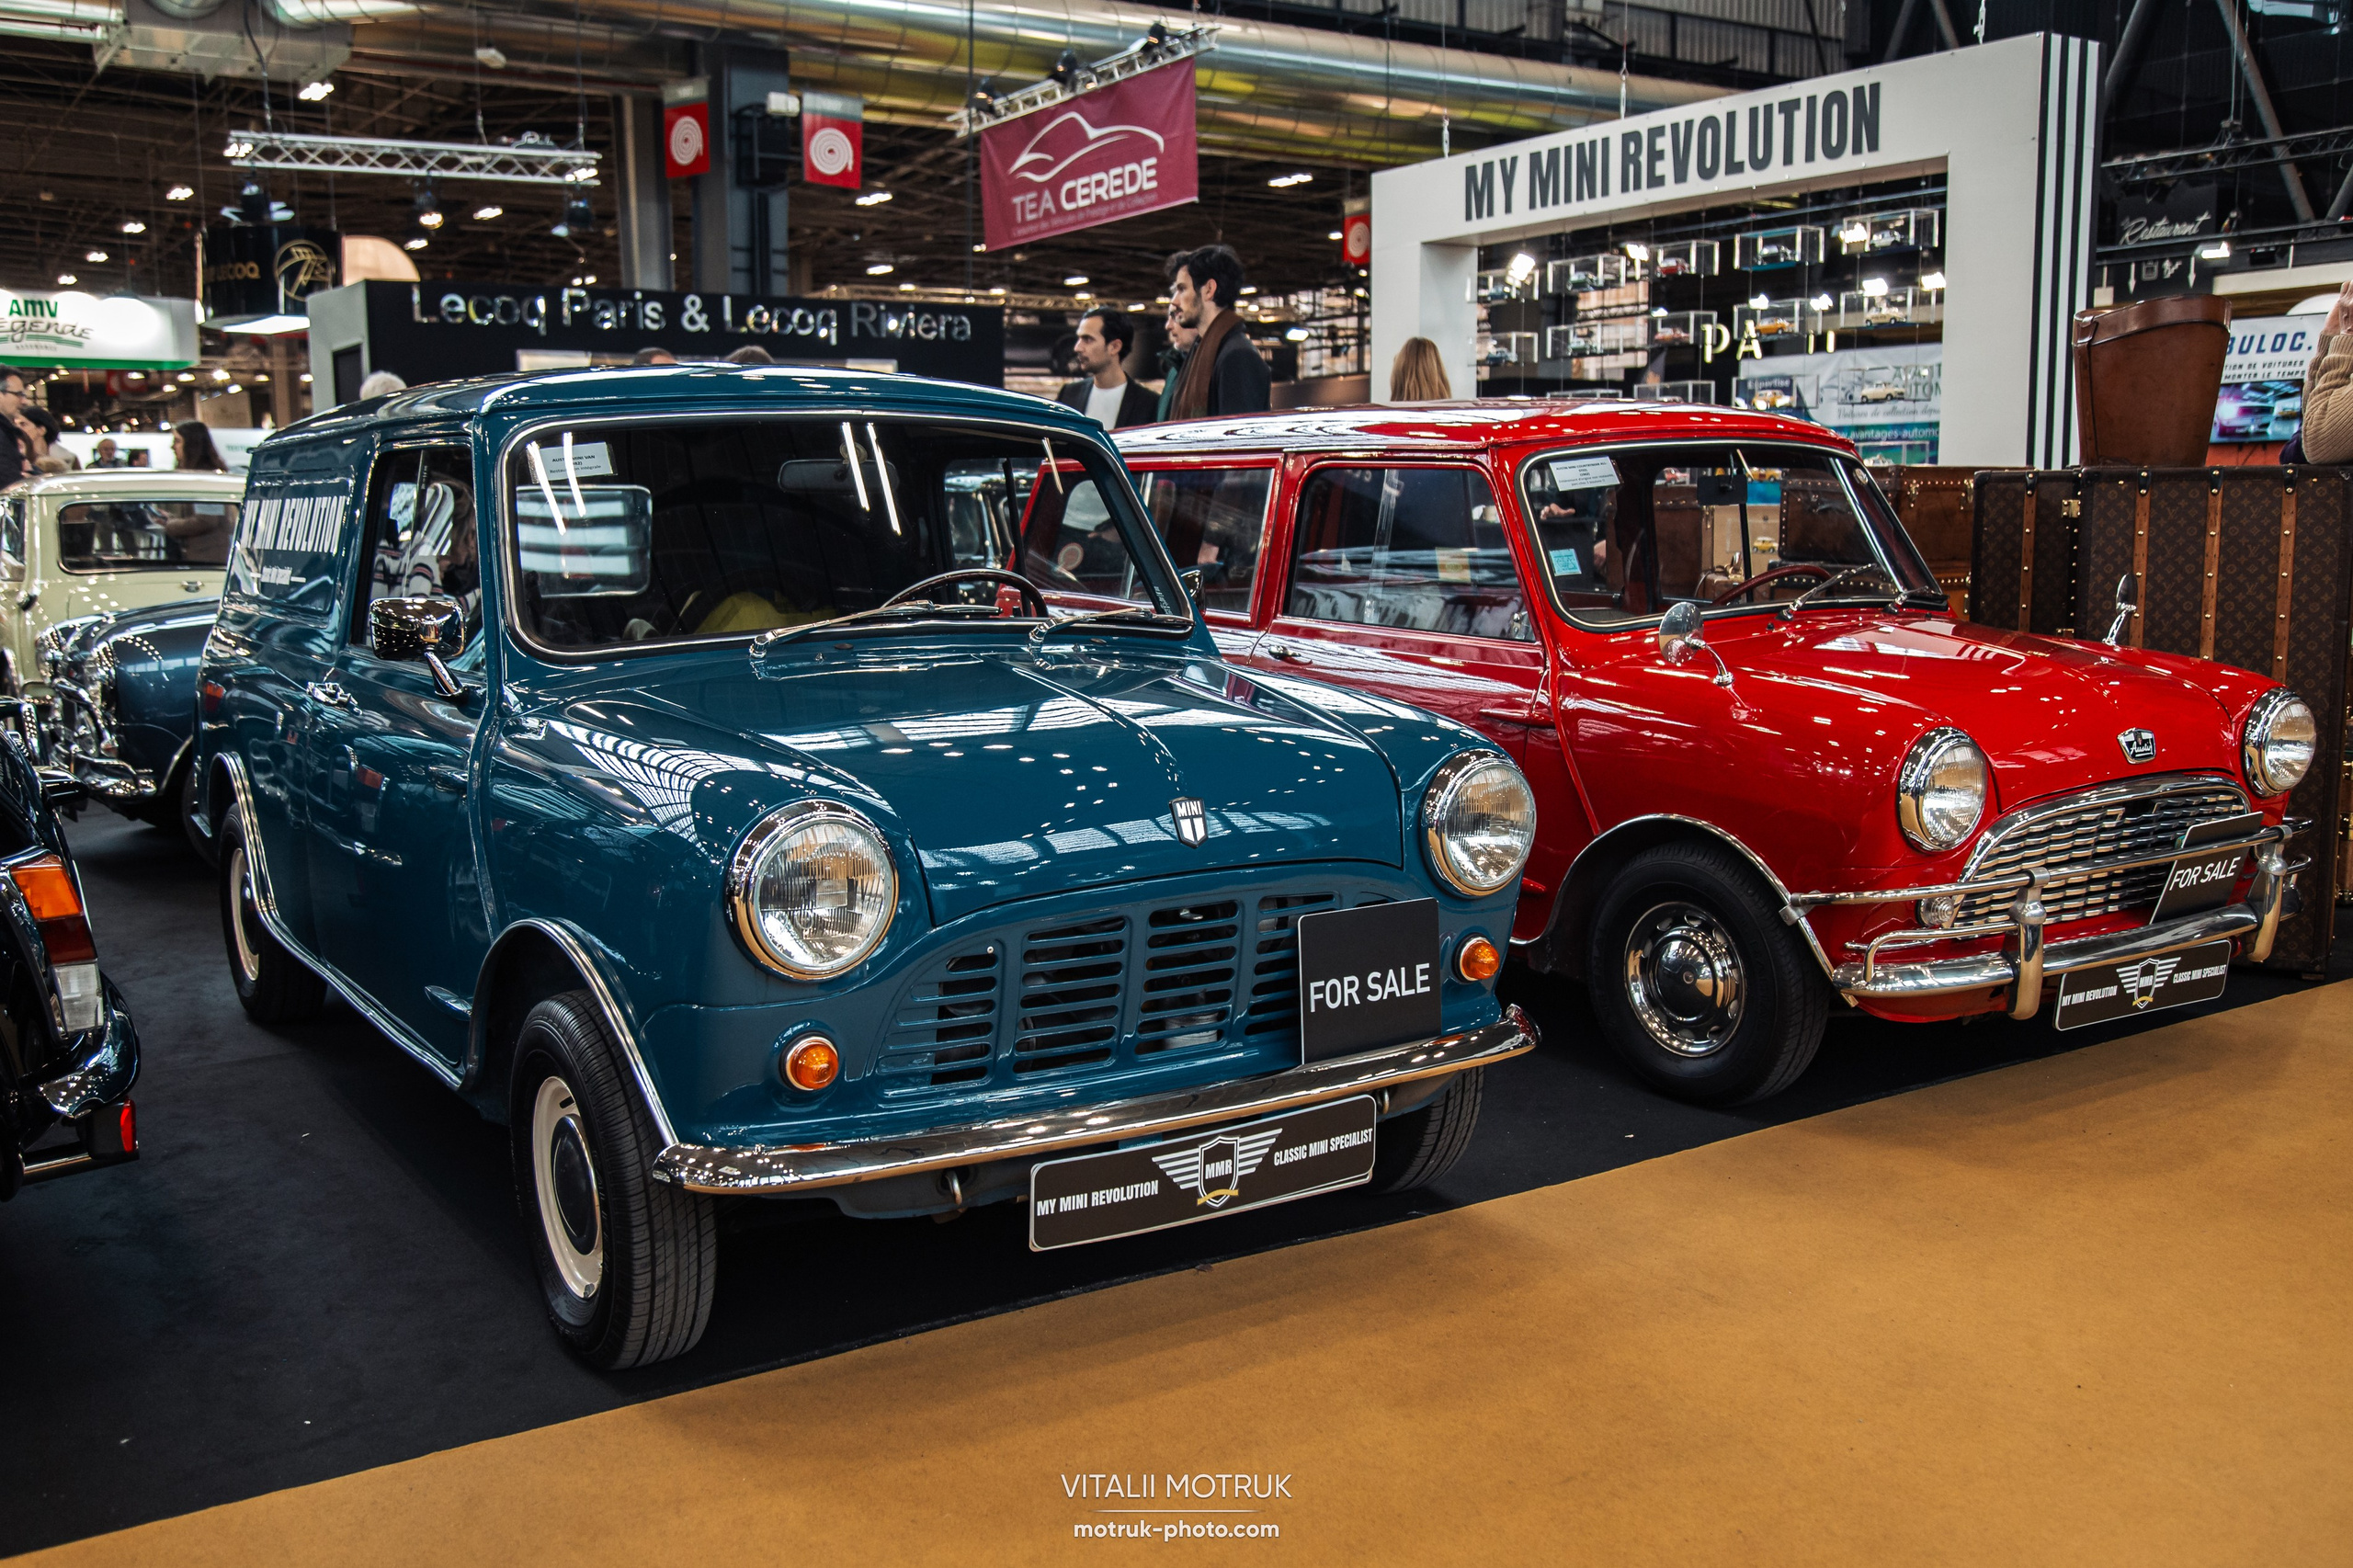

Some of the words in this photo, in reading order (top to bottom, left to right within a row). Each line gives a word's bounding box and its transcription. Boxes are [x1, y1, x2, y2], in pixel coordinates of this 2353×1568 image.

[1464, 155, 1518, 222] MY
[1529, 137, 1610, 210] MINI
[1620, 82, 1881, 194] REVOLUTION
[1012, 187, 1056, 223] TEA
[1060, 157, 1158, 211] CEREDE
[2119, 210, 2211, 246] Restaurant
[9, 299, 58, 318] AMV
[413, 282, 547, 336] Lecoq
[562, 288, 666, 331] Paris
[681, 293, 710, 333] &
[722, 294, 837, 347] Lecoq
[850, 301, 972, 342] Riviera
[2262, 359, 2305, 369] VOITURES
[276, 495, 346, 553] REVOLUTION
[1176, 801, 1202, 817] MINI
[2169, 866, 2202, 891] FOR
[2200, 857, 2242, 883] SALE
[1310, 975, 1360, 1013] FOR
[1367, 962, 1431, 1002] SALE
[2139, 975, 2154, 988] MMR
[2173, 971, 2191, 983] CLASSIC
[2191, 969, 2202, 980] MINI
[2202, 964, 2227, 979] SPECIALIST
[2062, 994, 2071, 1006] MY
[2071, 991, 2086, 1004] MINI
[2086, 985, 2118, 1002] REVOLUTION
[1273, 1144, 1308, 1166] CLASSIC
[1309, 1139, 1329, 1157] MINI
[1329, 1128, 1373, 1153] SPECIALIST
[1205, 1159, 1233, 1179] MMR
[1037, 1199, 1056, 1217] MY
[1059, 1193, 1088, 1213] MINI
[1091, 1179, 1159, 1207] REVOLUTION
